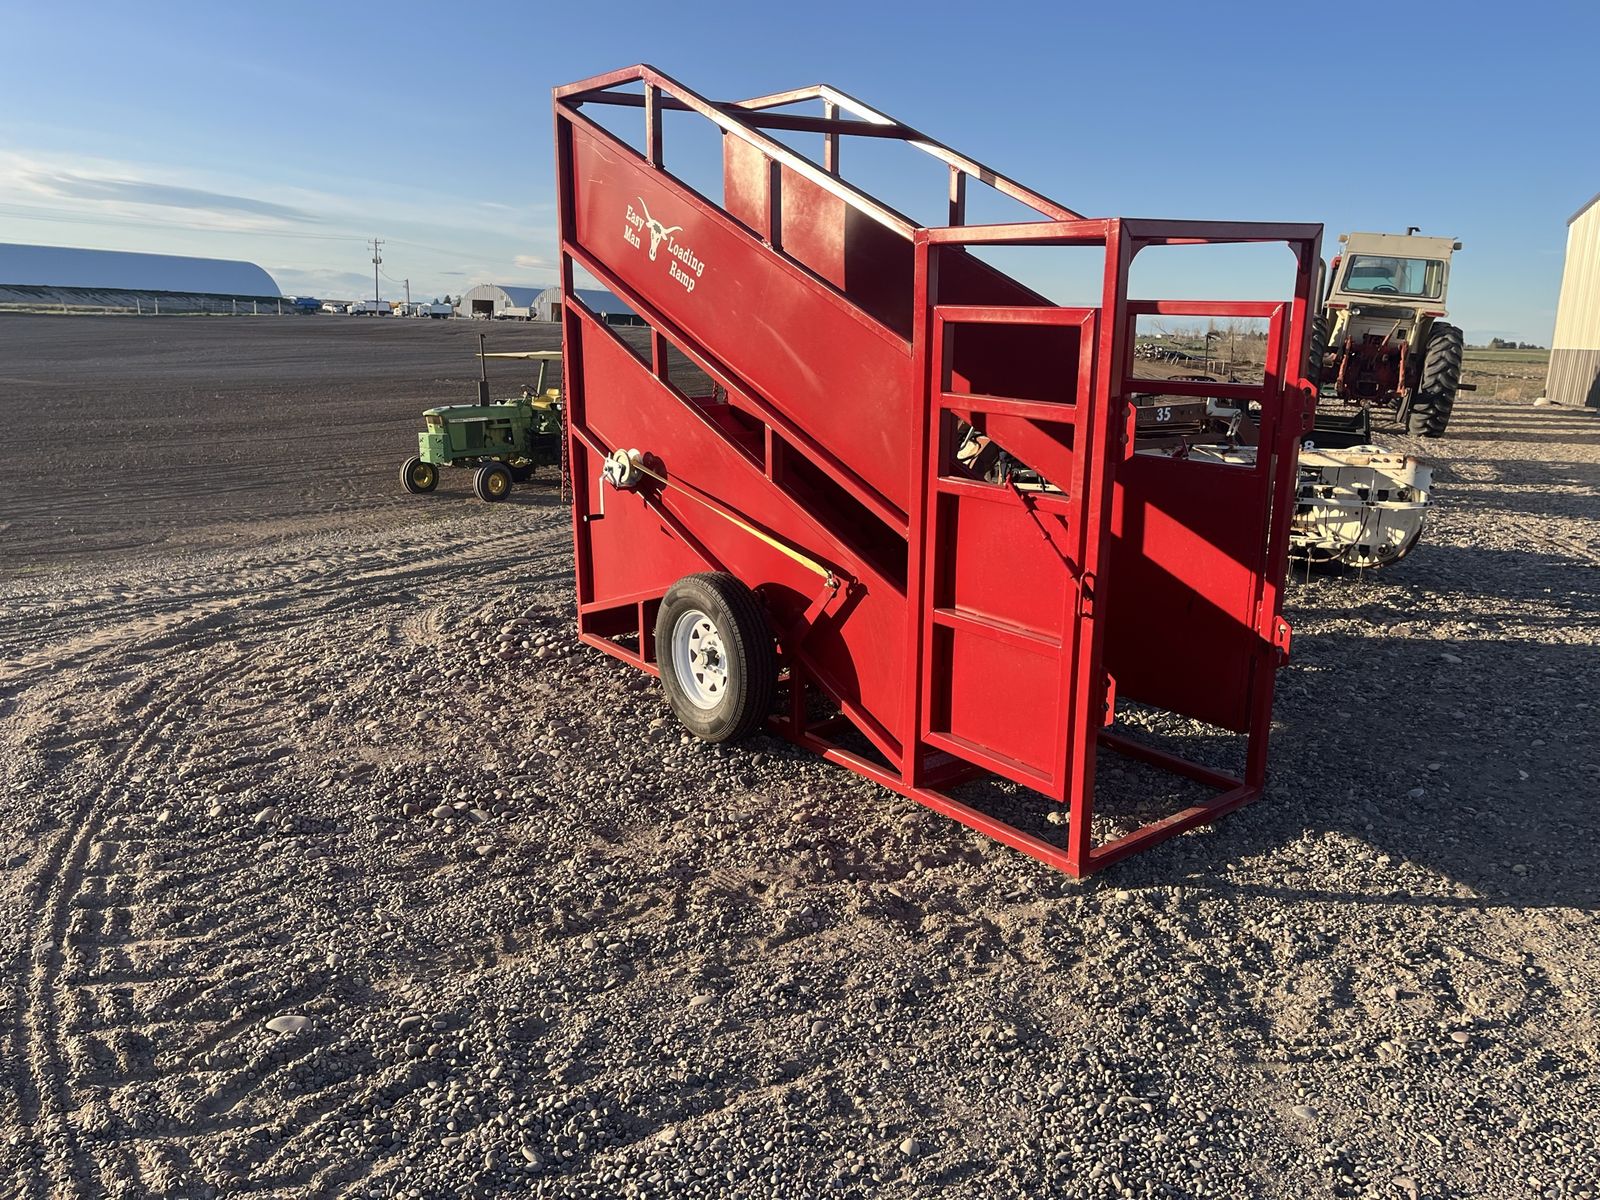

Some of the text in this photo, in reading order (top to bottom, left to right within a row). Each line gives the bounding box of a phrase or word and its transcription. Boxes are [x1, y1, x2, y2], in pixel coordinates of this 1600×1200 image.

[625, 204, 645, 232] Easy
[623, 224, 641, 250] Man
[667, 236, 705, 278] Loading
[669, 259, 696, 293] Ramp
[1156, 407, 1171, 422] 35
